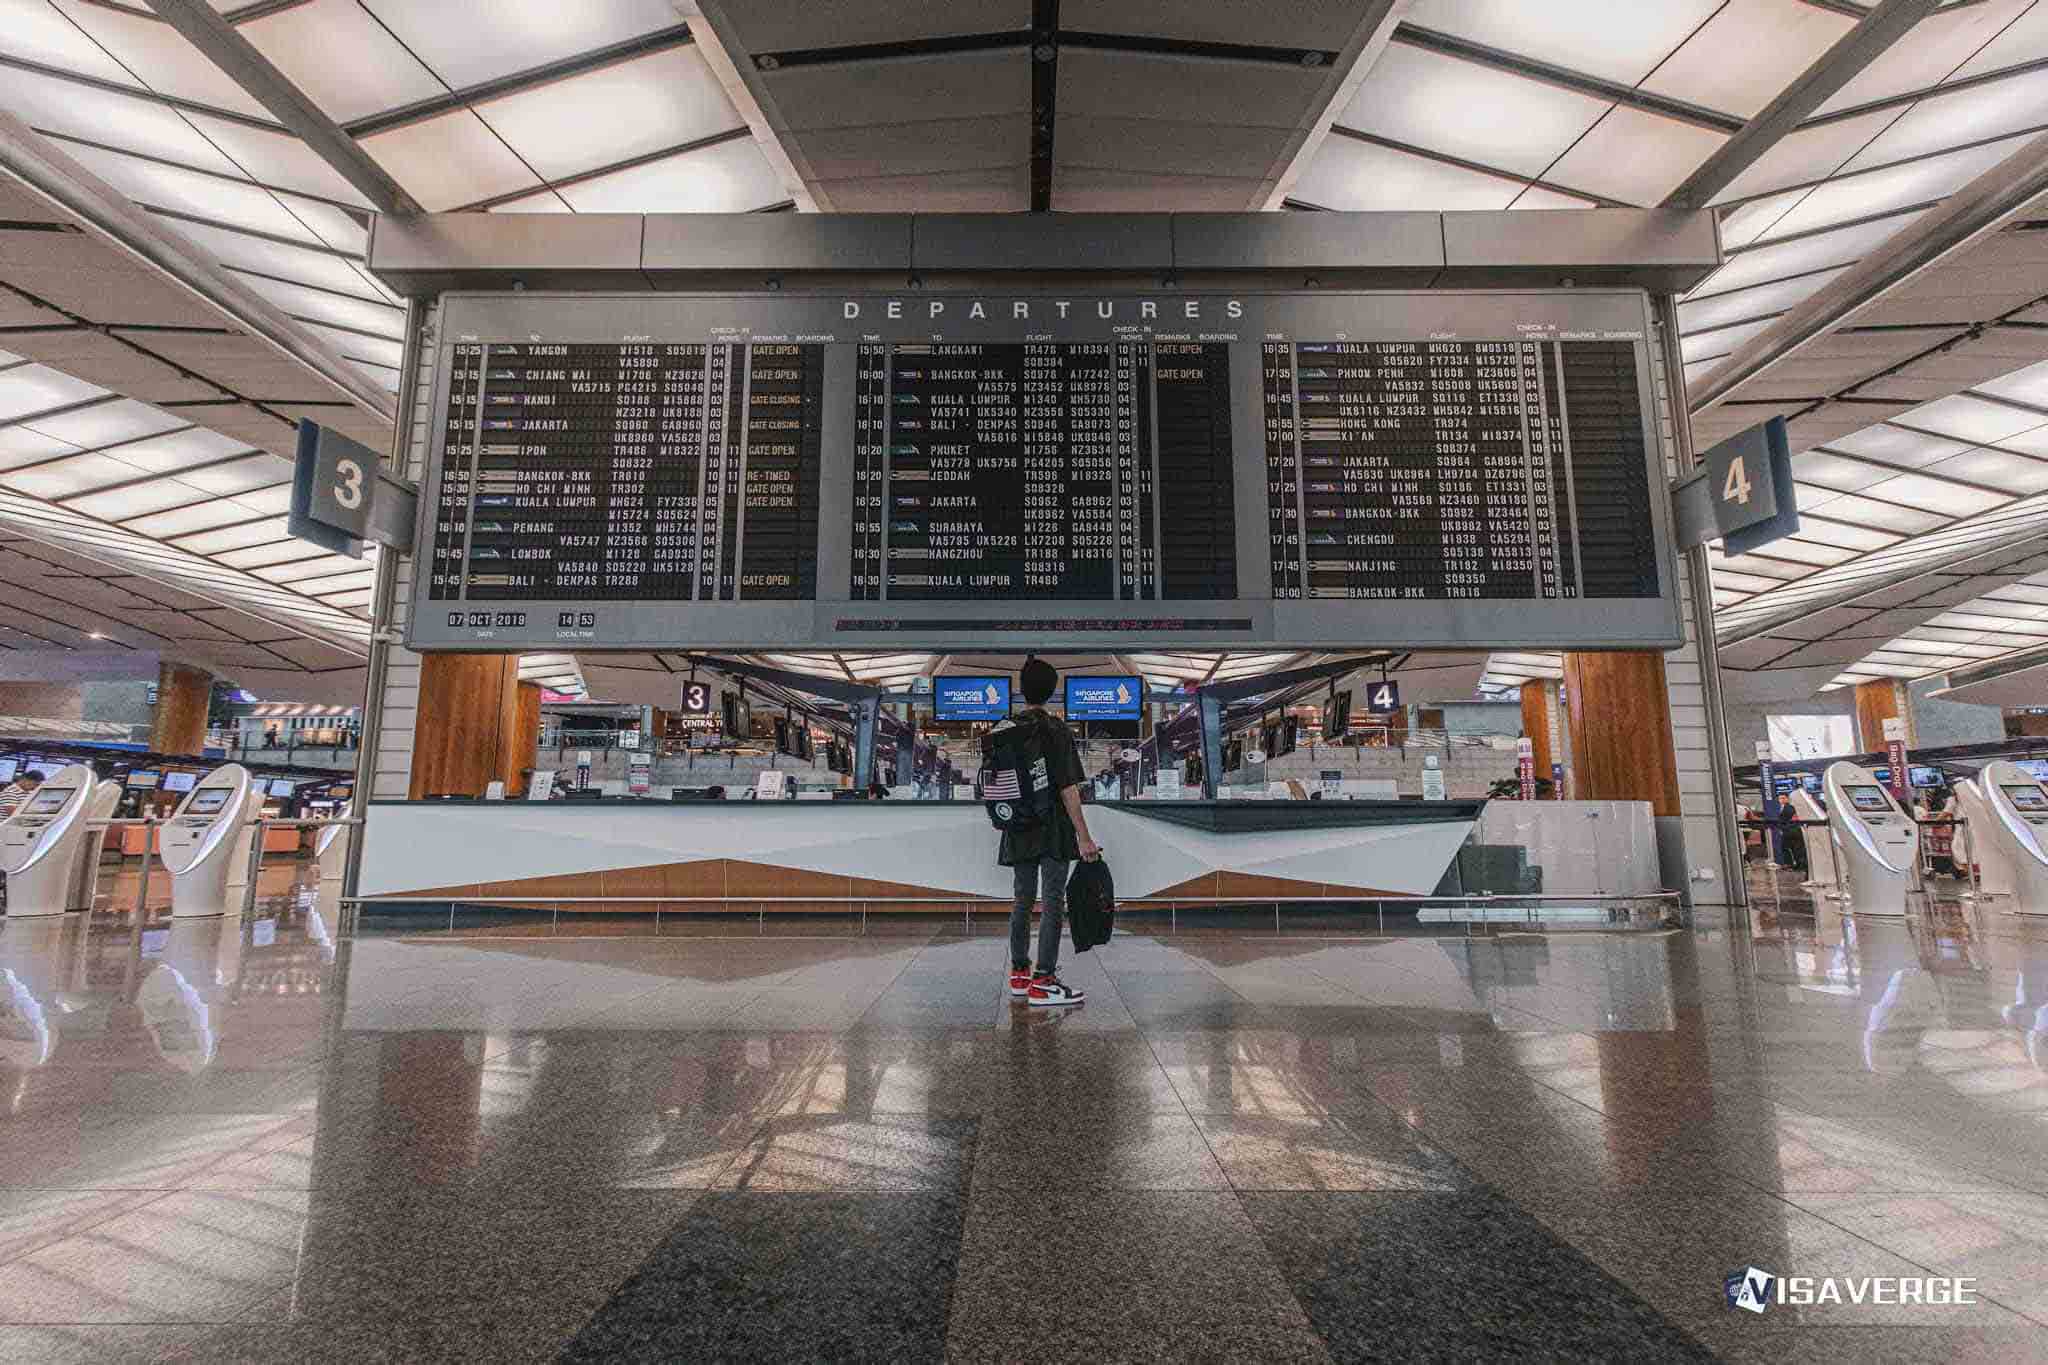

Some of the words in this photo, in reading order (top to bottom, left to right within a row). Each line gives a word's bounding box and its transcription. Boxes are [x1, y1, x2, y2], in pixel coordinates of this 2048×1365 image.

[843, 302, 1242, 318] DEPARTURES
[528, 346, 568, 355] YANGON
[713, 346, 724, 355] 04
[753, 345, 774, 355] GATE
[775, 345, 800, 355] OPEN
[930, 345, 983, 355] LANGKAWI
[1119, 345, 1128, 354] 10
[1157, 345, 1179, 354] GATE
[1180, 345, 1202, 354] OPEN
[1336, 344, 1369, 353] KUALA
[1376, 344, 1415, 353] LUMPUR
[526, 370, 565, 380] CHIANG
[572, 370, 591, 380] MAI
[752, 370, 773, 380] GATE
[775, 370, 798, 380] OPEN
[1157, 369, 1179, 379] GATE
[1181, 369, 1203, 379] OPEN
[1338, 368, 1370, 378] PHNOM
[1377, 368, 1404, 378] PENH
[524, 395, 556, 405] HANOI
[751, 395, 769, 405] GATE
[769, 395, 800, 405] CLOSING
[930, 395, 963, 405] KUALA
[971, 395, 1010, 405] LUMPUR
[1339, 393, 1372, 403] KUALA
[1379, 393, 1419, 403] LUMPUR
[522, 420, 568, 430] JAKARTA
[750, 421, 768, 430] GATE
[768, 421, 799, 430] CLOSING
[930, 420, 956, 430] BALI
[977, 420, 1017, 430] DENPAS
[1340, 419, 1367, 429] HONG
[1374, 419, 1400, 429] KONG
[521, 445, 547, 455] IPOH
[749, 446, 769, 456] GATE
[772, 446, 795, 456] OPEN
[930, 445, 970, 455] PHUKET
[1344, 457, 1390, 467] JAKARTA
[930, 471, 971, 480] JEDDAH
[1723, 456, 1751, 505] 4
[334, 460, 363, 509] 3
[516, 484, 530, 494] HO
[537, 484, 556, 494] CHI
[563, 484, 591, 494] MINH
[746, 484, 767, 494] GATE
[770, 484, 793, 494] OPEN
[1344, 483, 1356, 493] HO
[1364, 483, 1383, 493] CHI
[1392, 483, 1418, 493] MINH
[515, 497, 549, 507] KUALA
[556, 497, 596, 507] LUMPUR
[746, 497, 767, 506] GATE
[769, 497, 793, 506] OPEN
[929, 497, 977, 506] JAKARTA
[513, 522, 554, 532] PENANG
[929, 523, 983, 533] SURABAYA
[1347, 535, 1394, 545] CHENGDU
[511, 549, 552, 559] LOMBOK
[929, 549, 983, 559] HANGZHOU
[1348, 561, 1396, 571] NANJING
[509, 575, 535, 585] BALI
[556, 575, 597, 585] DENPAS
[703, 576, 712, 585] 10
[742, 576, 765, 585] GATE
[767, 576, 789, 585] OPEN
[928, 576, 962, 585] KUALA
[970, 576, 1010, 585] LUMPUR
[688, 686, 704, 709] 3
[1374, 685, 1393, 709] 4
[1889, 745, 1901, 788] Bag-Drop
